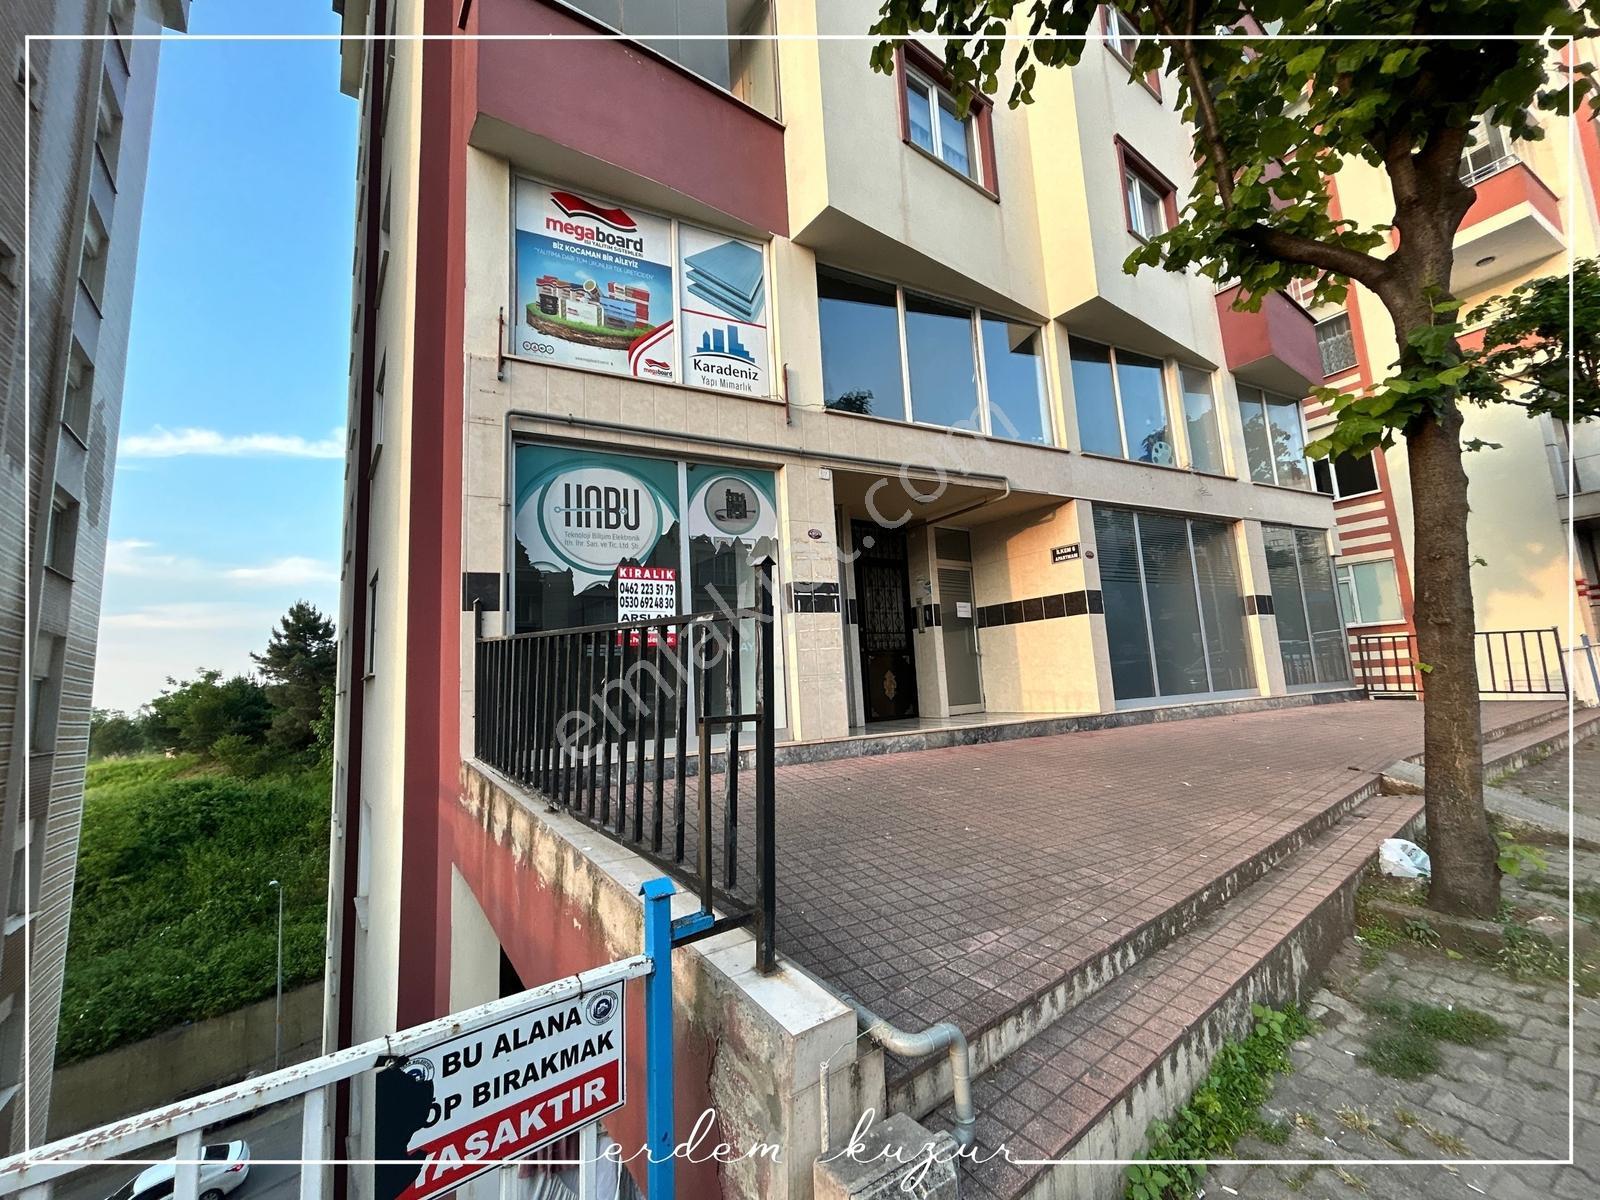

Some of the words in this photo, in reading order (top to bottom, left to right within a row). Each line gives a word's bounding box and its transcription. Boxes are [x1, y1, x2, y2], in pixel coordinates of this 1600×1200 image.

[545, 216, 644, 253] megaboard
[552, 241, 564, 251] BİZ
[565, 245, 601, 259] KOCAMAN
[602, 253, 614, 262] BİR
[614, 256, 639, 268] AİLEYİZ
[643, 367, 672, 378] megaboard
[693, 358, 759, 381] Karadeniz
[701, 375, 718, 388] Yapı
[564, 483, 640, 531] HABU
[612, 533, 640, 542] Elektronik
[619, 582, 639, 595] 0462
[640, 583, 654, 595] 223
[656, 584, 664, 596] 51
[665, 584, 674, 596] 79
[619, 596, 639, 609] 0530
[640, 597, 653, 609] 692
[654, 598, 664, 609] 48
[665, 598, 674, 609] 30
[620, 613, 673, 622] ARSLA
[442, 1041, 483, 1079] BU
[491, 1006, 583, 1060] ALANA
[425, 1092, 463, 1129] ÖP
[472, 1028, 616, 1109] BIRAKMAK
[413, 1075, 608, 1190] YASAKTIR
